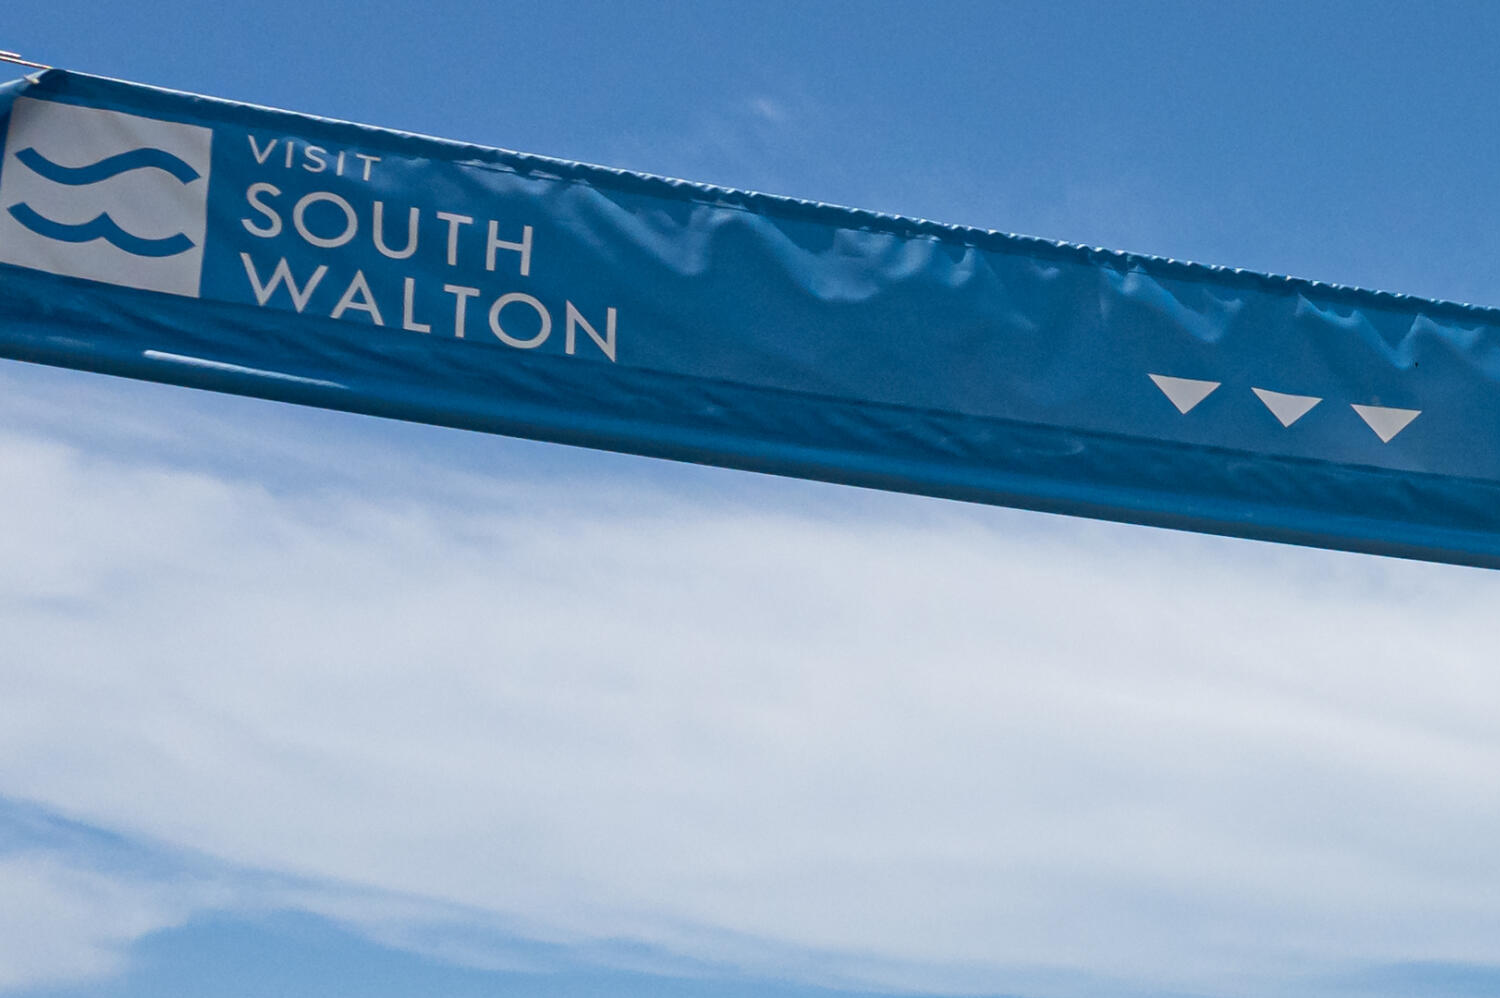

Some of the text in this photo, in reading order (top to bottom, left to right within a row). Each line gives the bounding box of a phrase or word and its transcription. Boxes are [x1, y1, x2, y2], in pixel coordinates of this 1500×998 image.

[247, 134, 382, 182] VISIT
[241, 182, 533, 276] SOUTH
[240, 252, 618, 363] WALTON
